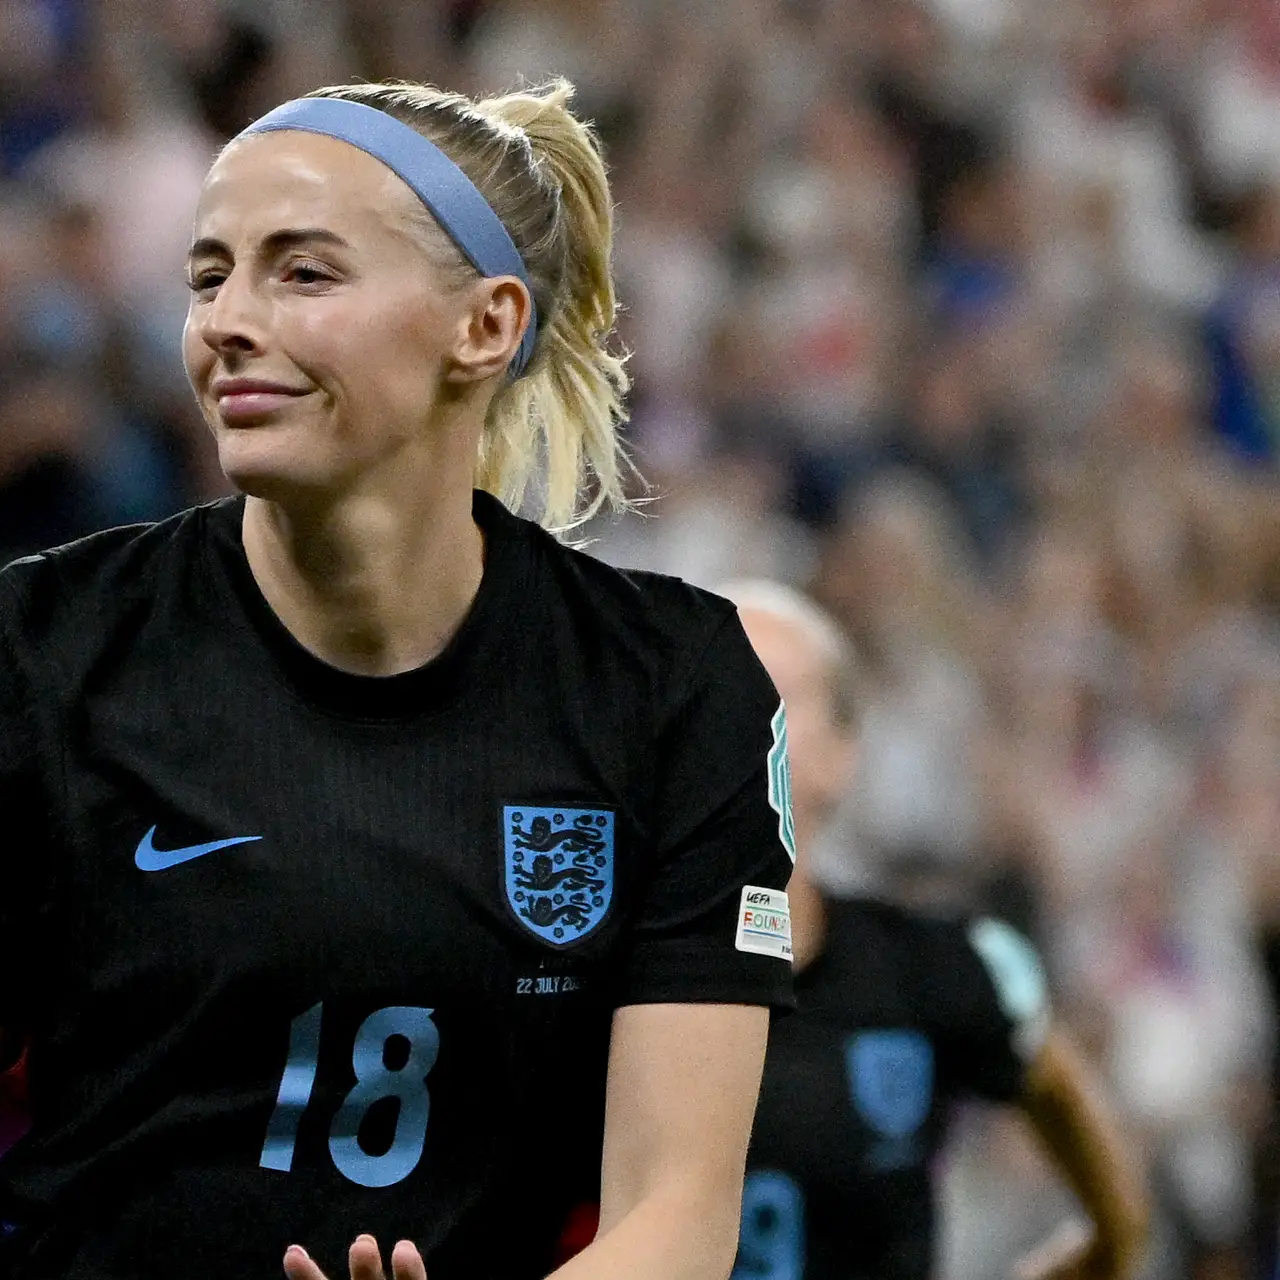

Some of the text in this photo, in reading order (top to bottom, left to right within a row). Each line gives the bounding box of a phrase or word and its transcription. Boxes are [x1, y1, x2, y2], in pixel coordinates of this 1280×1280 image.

[746, 892, 771, 905] UEFA
[516, 977, 533, 994] 22
[534, 976, 561, 994] JULY
[259, 1000, 440, 1189] 18
